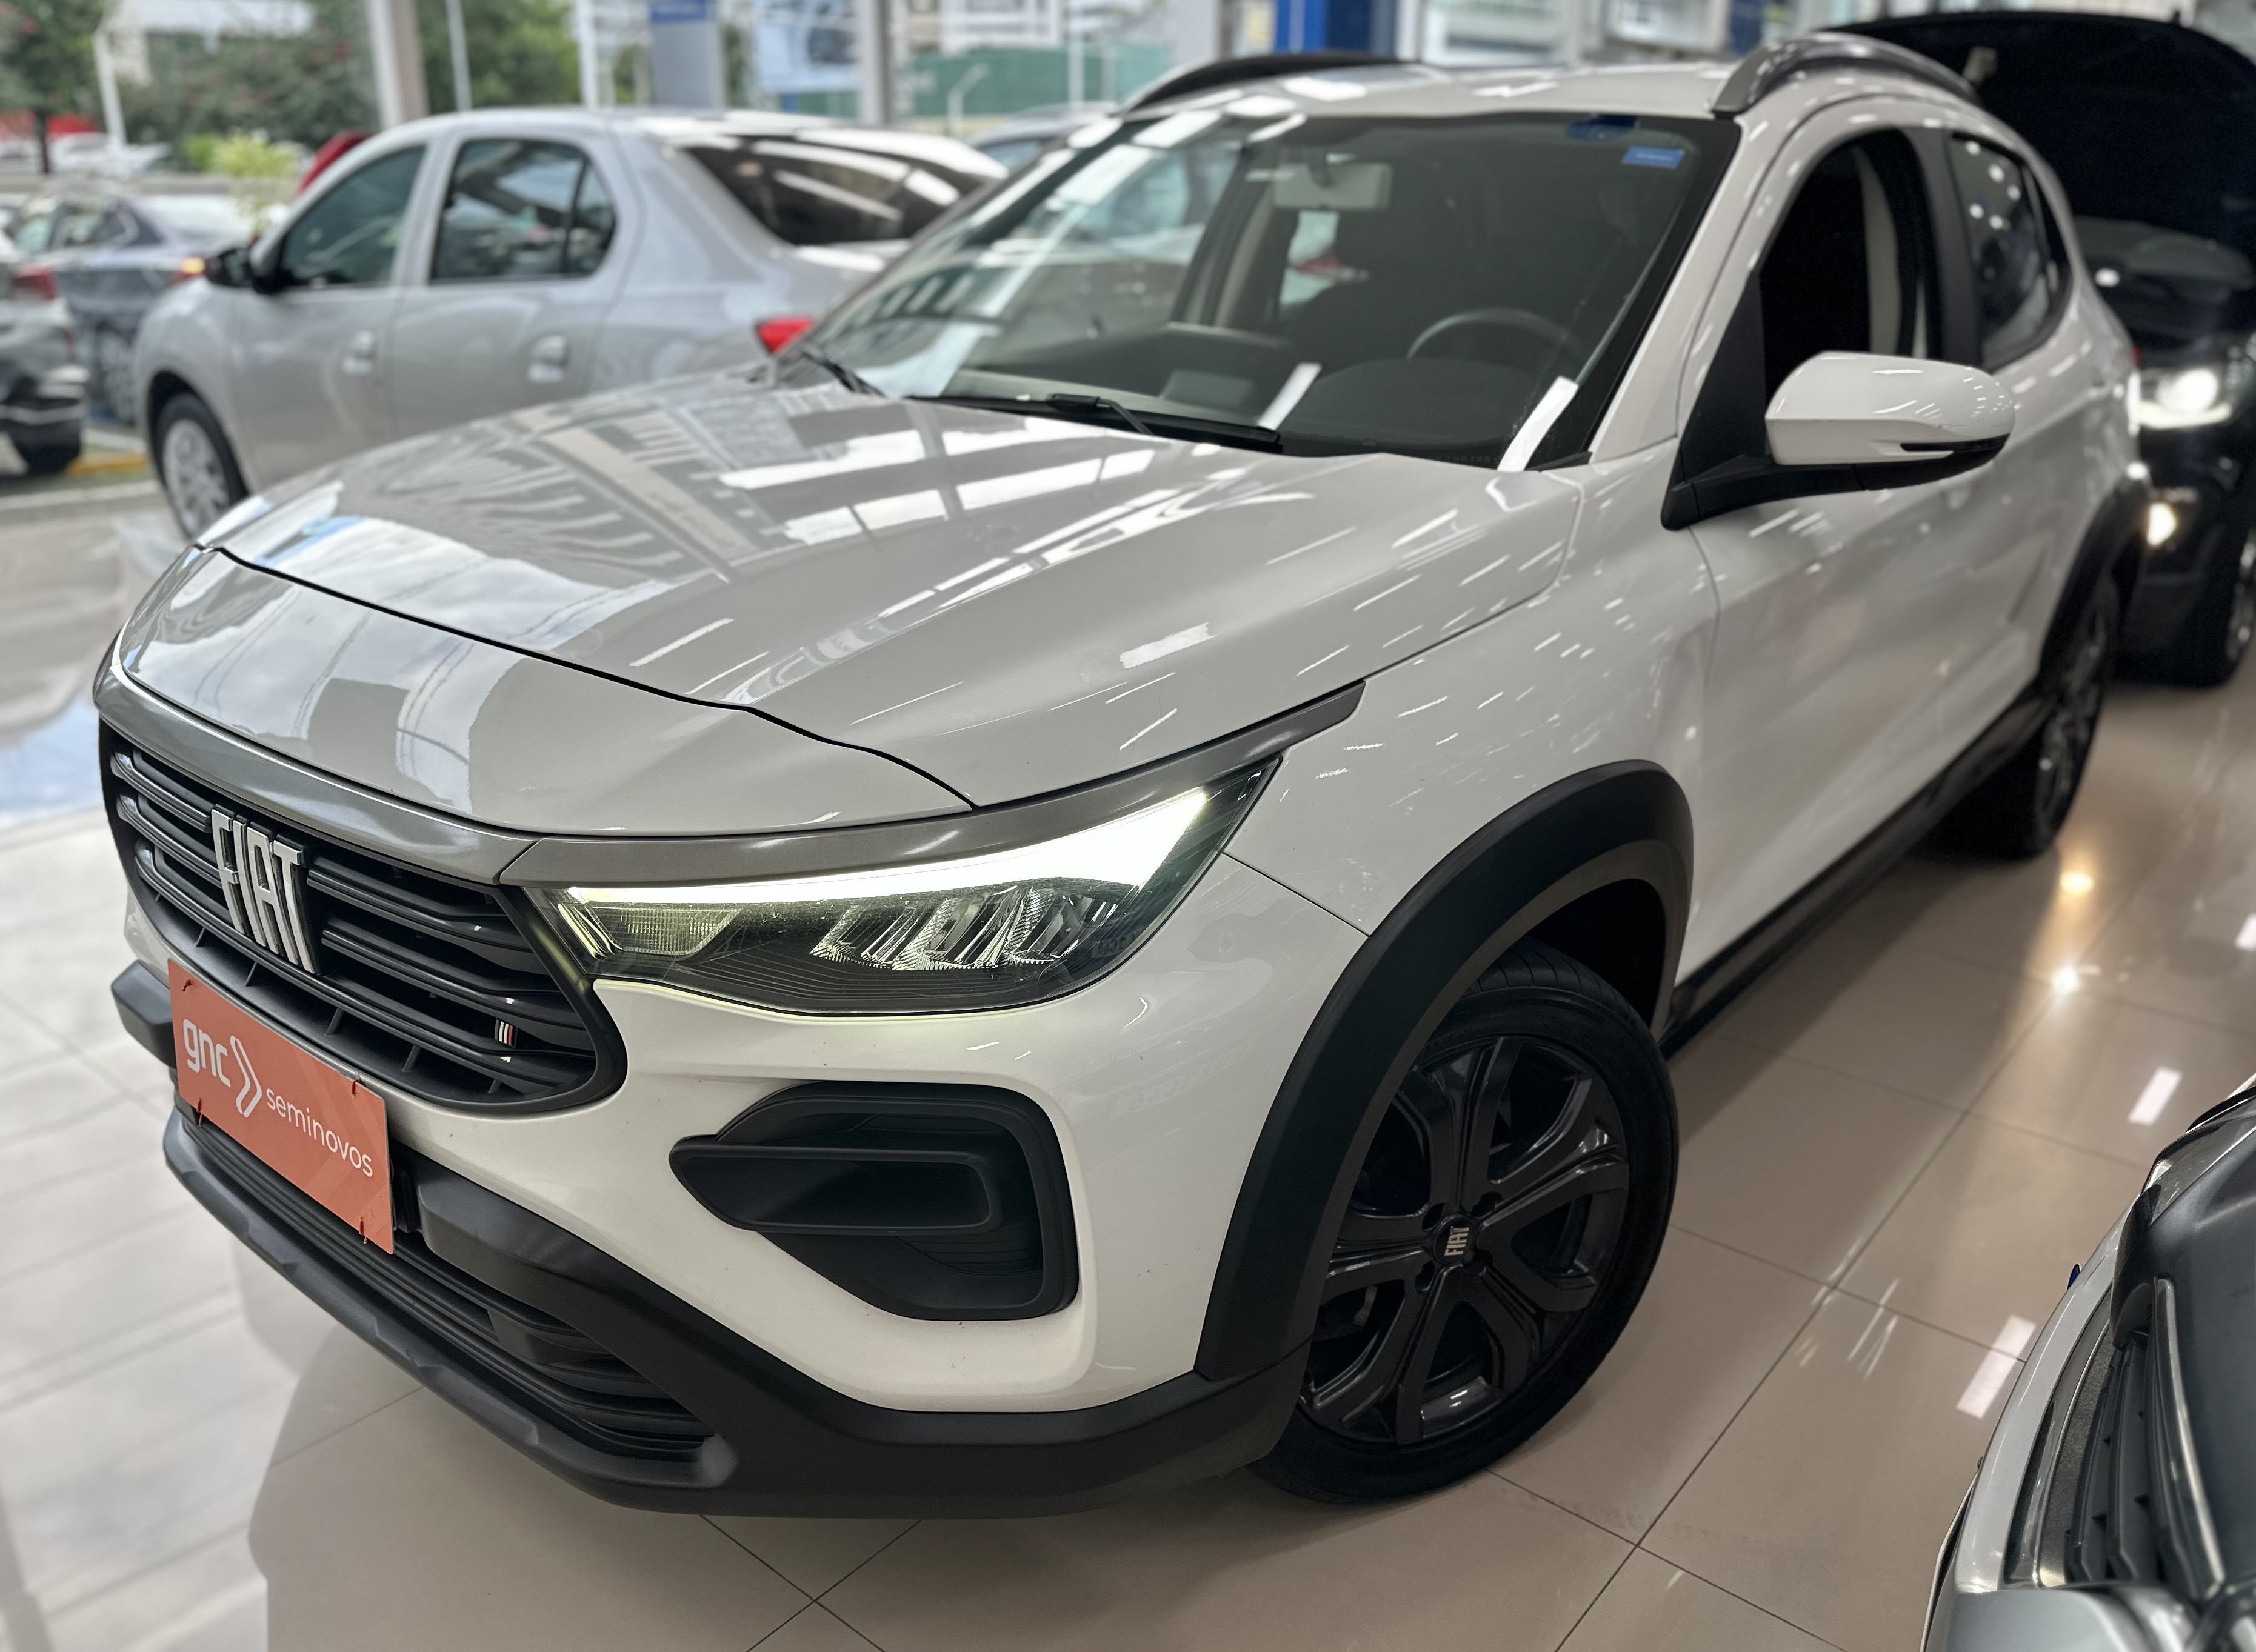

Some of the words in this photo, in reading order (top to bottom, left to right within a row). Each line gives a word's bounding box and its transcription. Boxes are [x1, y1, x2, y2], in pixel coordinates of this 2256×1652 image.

[212, 807, 315, 974] FIAT
[183, 1019, 231, 1088] gnc
[266, 1088, 373, 1178] seminovos
[1444, 1225, 1469, 1256] FIAT
